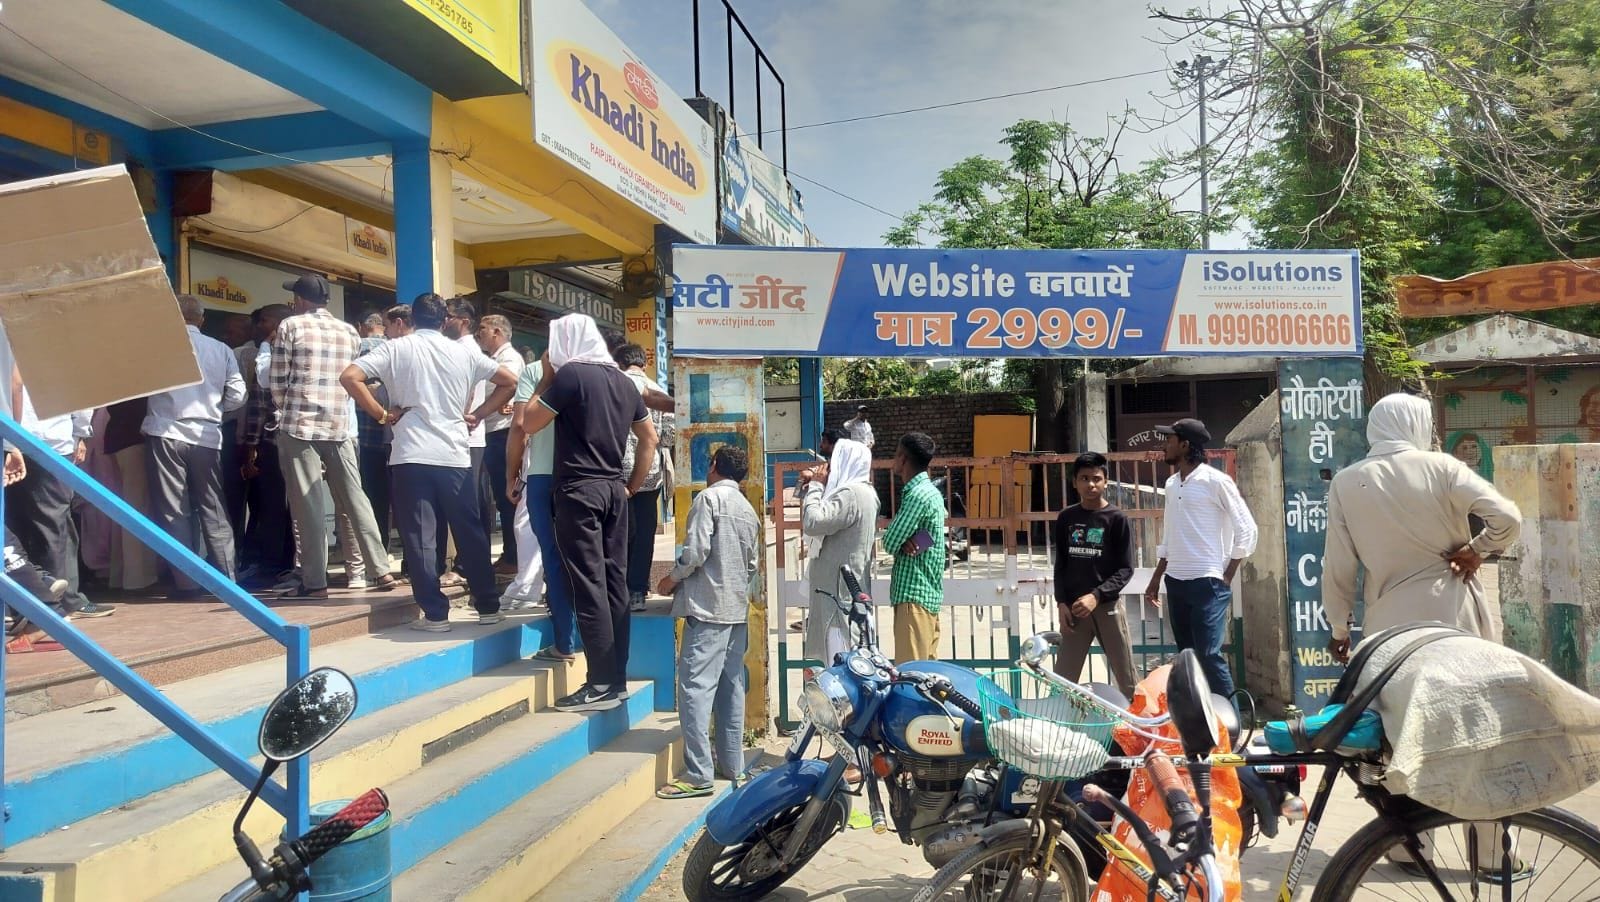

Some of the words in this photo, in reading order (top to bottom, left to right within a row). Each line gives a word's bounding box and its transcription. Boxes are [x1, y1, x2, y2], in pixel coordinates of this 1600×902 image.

[570, 53, 645, 151] Khadi
[650, 121, 697, 190] India
[353, 233, 371, 250] Khadi
[373, 240, 387, 256] India
[872, 262, 1015, 297] Website
[1025, 264, 1134, 297] बनवायें
[1203, 261, 1343, 282] iSolutions
[198, 283, 224, 297] Khadi
[226, 287, 246, 304] India
[523, 270, 624, 326] iSolutions
[738, 275, 807, 311] जींद
[1214, 299, 1328, 310] www.isolutions.co.in
[626, 312, 653, 334] खादी
[697, 316, 775, 329] www.cityjind.com
[874, 312, 957, 346] मात्र
[966, 307, 1143, 349] 2999/-
[1179, 314, 1203, 345] M.
[1208, 313, 1351, 345] 9996806666
[1127, 430, 1151, 447] नगर
[1309, 421, 1335, 463] ही
[918, 737, 953, 746] ENFIELD
[921, 729, 950, 739] ROYAL
